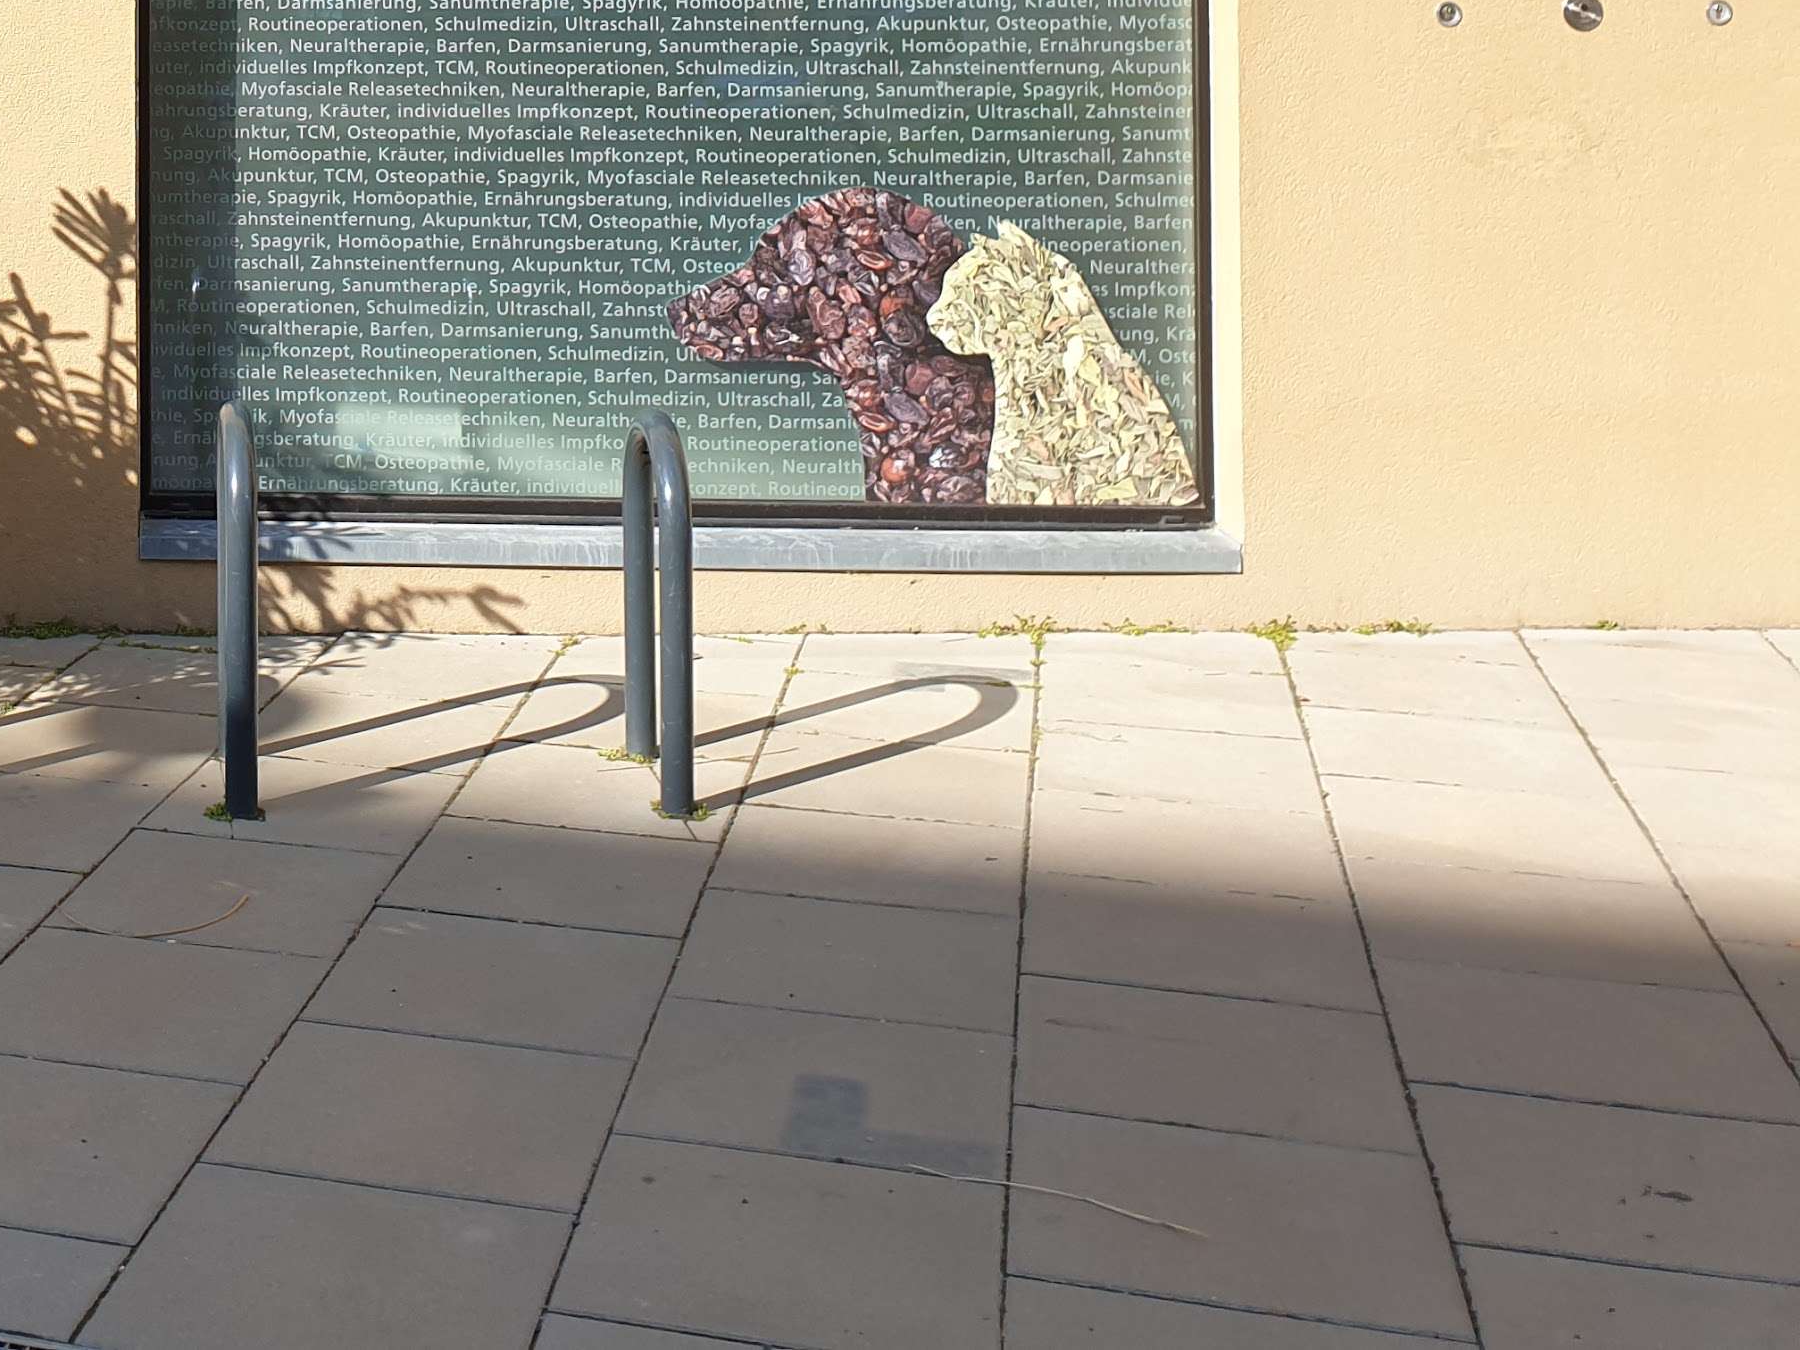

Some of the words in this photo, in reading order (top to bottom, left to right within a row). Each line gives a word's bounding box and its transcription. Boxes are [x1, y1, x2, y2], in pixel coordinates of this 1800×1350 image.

[249, 16, 427, 34] Routineoperationen,
[436, 16, 557, 34] Schulmedizin,
[566, 16, 664, 34] Ultraschall,
[672, 15, 868, 33] Zahnsteinentfernung,
[877, 15, 988, 33] Akupunktur,
[997, 15, 1111, 33] Osteopathie,
[291, 38, 429, 56] Neuraltherapie,
[437, 38, 500, 56] Barfen,
[509, 38, 651, 56] Darmsanierung,
[660, 38, 803, 56] Sanumtherapie,
[811, 38, 893, 56] Spagyrik,
[902, 38, 1031, 56] Homöopathie,
[314, 60, 428, 78] Impfkonzept,
[435, 58, 478, 76] TCM,
[486, 60, 668, 78] Routineoperationen,
[676, 60, 798, 78] Schulmedizin,
[806, 60, 903, 78] Ultraschall,
[911, 60, 1104, 78] Zahnsteinentfernung,
[249, 147, 371, 165] Homöopathie,
[379, 148, 446, 166] Kräuter,
[455, 148, 564, 163] individuelles
[571, 148, 688, 166] Impfkonzept,
[697, 149, 880, 167] Routineoperationen,
[888, 149, 1010, 167] Schulmedizin,
[1018, 149, 1115, 167] Ultraschall,
[268, 190, 345, 208] Spagyrik,
[354, 191, 476, 209] Homöopathie,
[485, 191, 671, 209] Ernährungsberatung,
[680, 192, 790, 207] individuelles
[923, 192, 1108, 210] Routineoperationen,
[251, 233, 330, 251] Spagyrik,
[339, 234, 464, 252] Homöopathie,
[473, 234, 662, 252] Ernährungsberatung,
[671, 235, 741, 253] Kräuter,
[312, 256, 504, 274] Zahnsteinentfernung,
[512, 256, 623, 274] Akupunktur,
[631, 256, 675, 274] TCM,
[343, 278, 481, 296] Sanumtherapie,
[490, 279, 570, 297] Spagyrik,
[367, 300, 488, 318] Schulmedizin,
[497, 301, 595, 319] Ultraschall,
[371, 322, 433, 340] Barfen,
[442, 323, 582, 341] Darmsanierung,
[362, 344, 541, 362] Routineoperationen,
[549, 345, 668, 363] Schulmedizin,
[284, 366, 441, 384] Releasetechniken,
[450, 367, 586, 385] Neuraltherapie,
[595, 367, 657, 385] Barfen,
[665, 368, 805, 386] Darmsanierung,
[276, 388, 391, 406] Impfkonzept,
[399, 389, 581, 407] Routineoperationen,
[589, 390, 709, 408] Schulmedizin,
[718, 390, 815, 408] Ultraschall,
